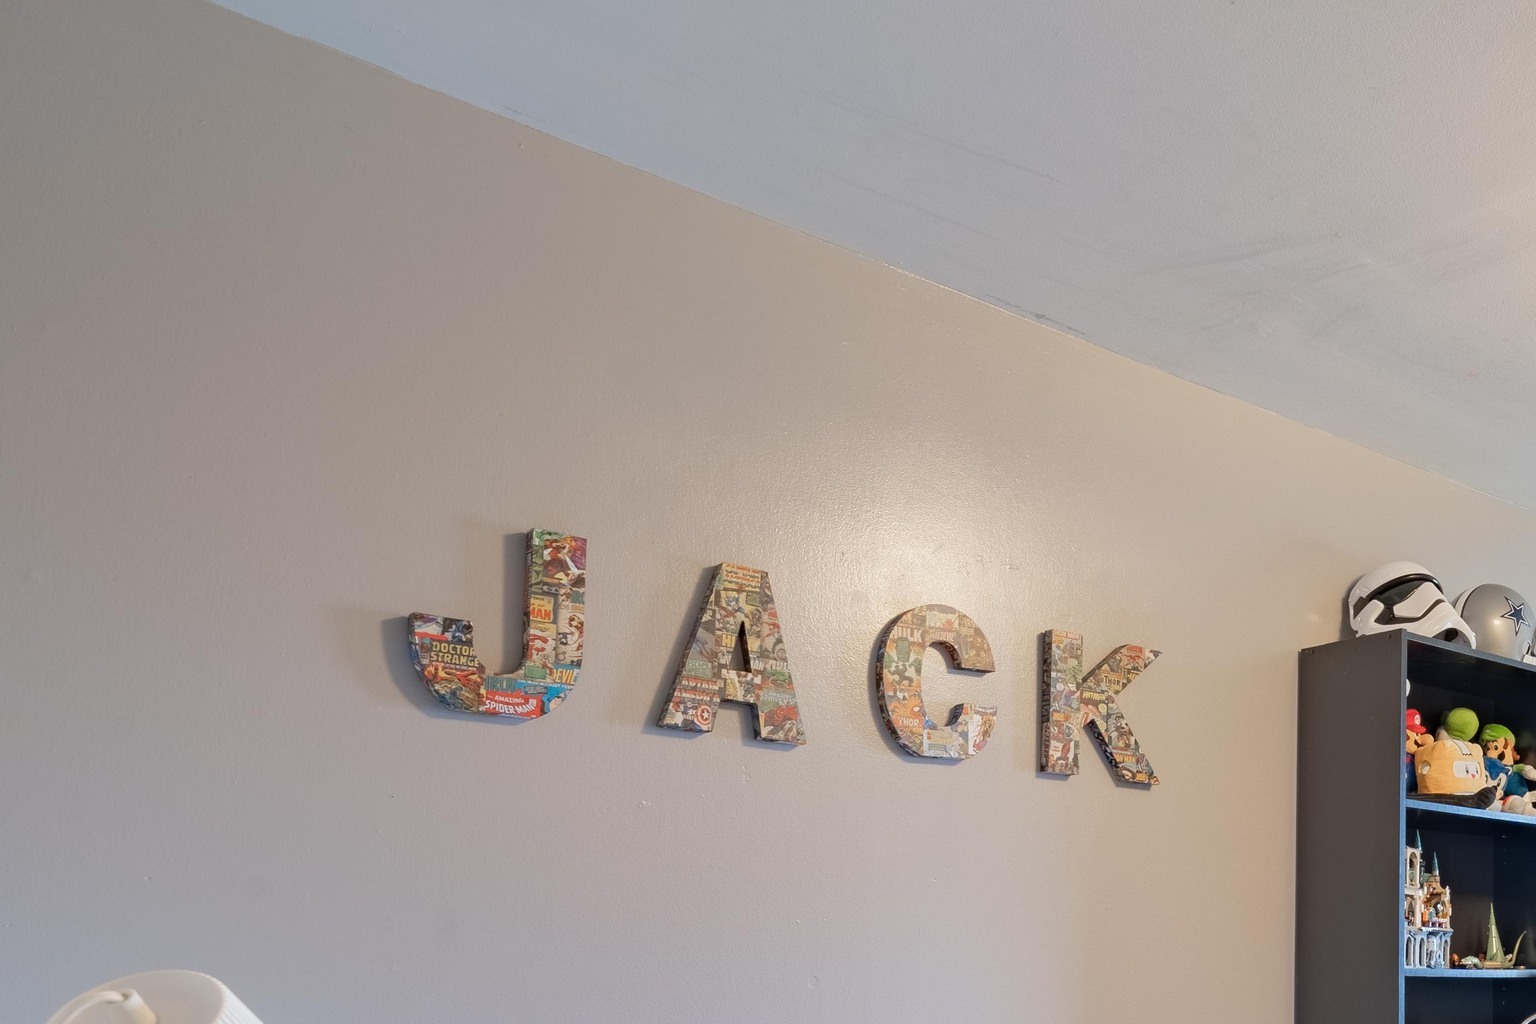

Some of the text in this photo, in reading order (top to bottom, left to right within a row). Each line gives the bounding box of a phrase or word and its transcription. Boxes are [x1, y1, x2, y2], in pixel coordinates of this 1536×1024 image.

[432, 641, 477, 656] DOCTOR
[430, 651, 481, 667] STRANGE
[485, 699, 537, 714] SPIDER-MAN
